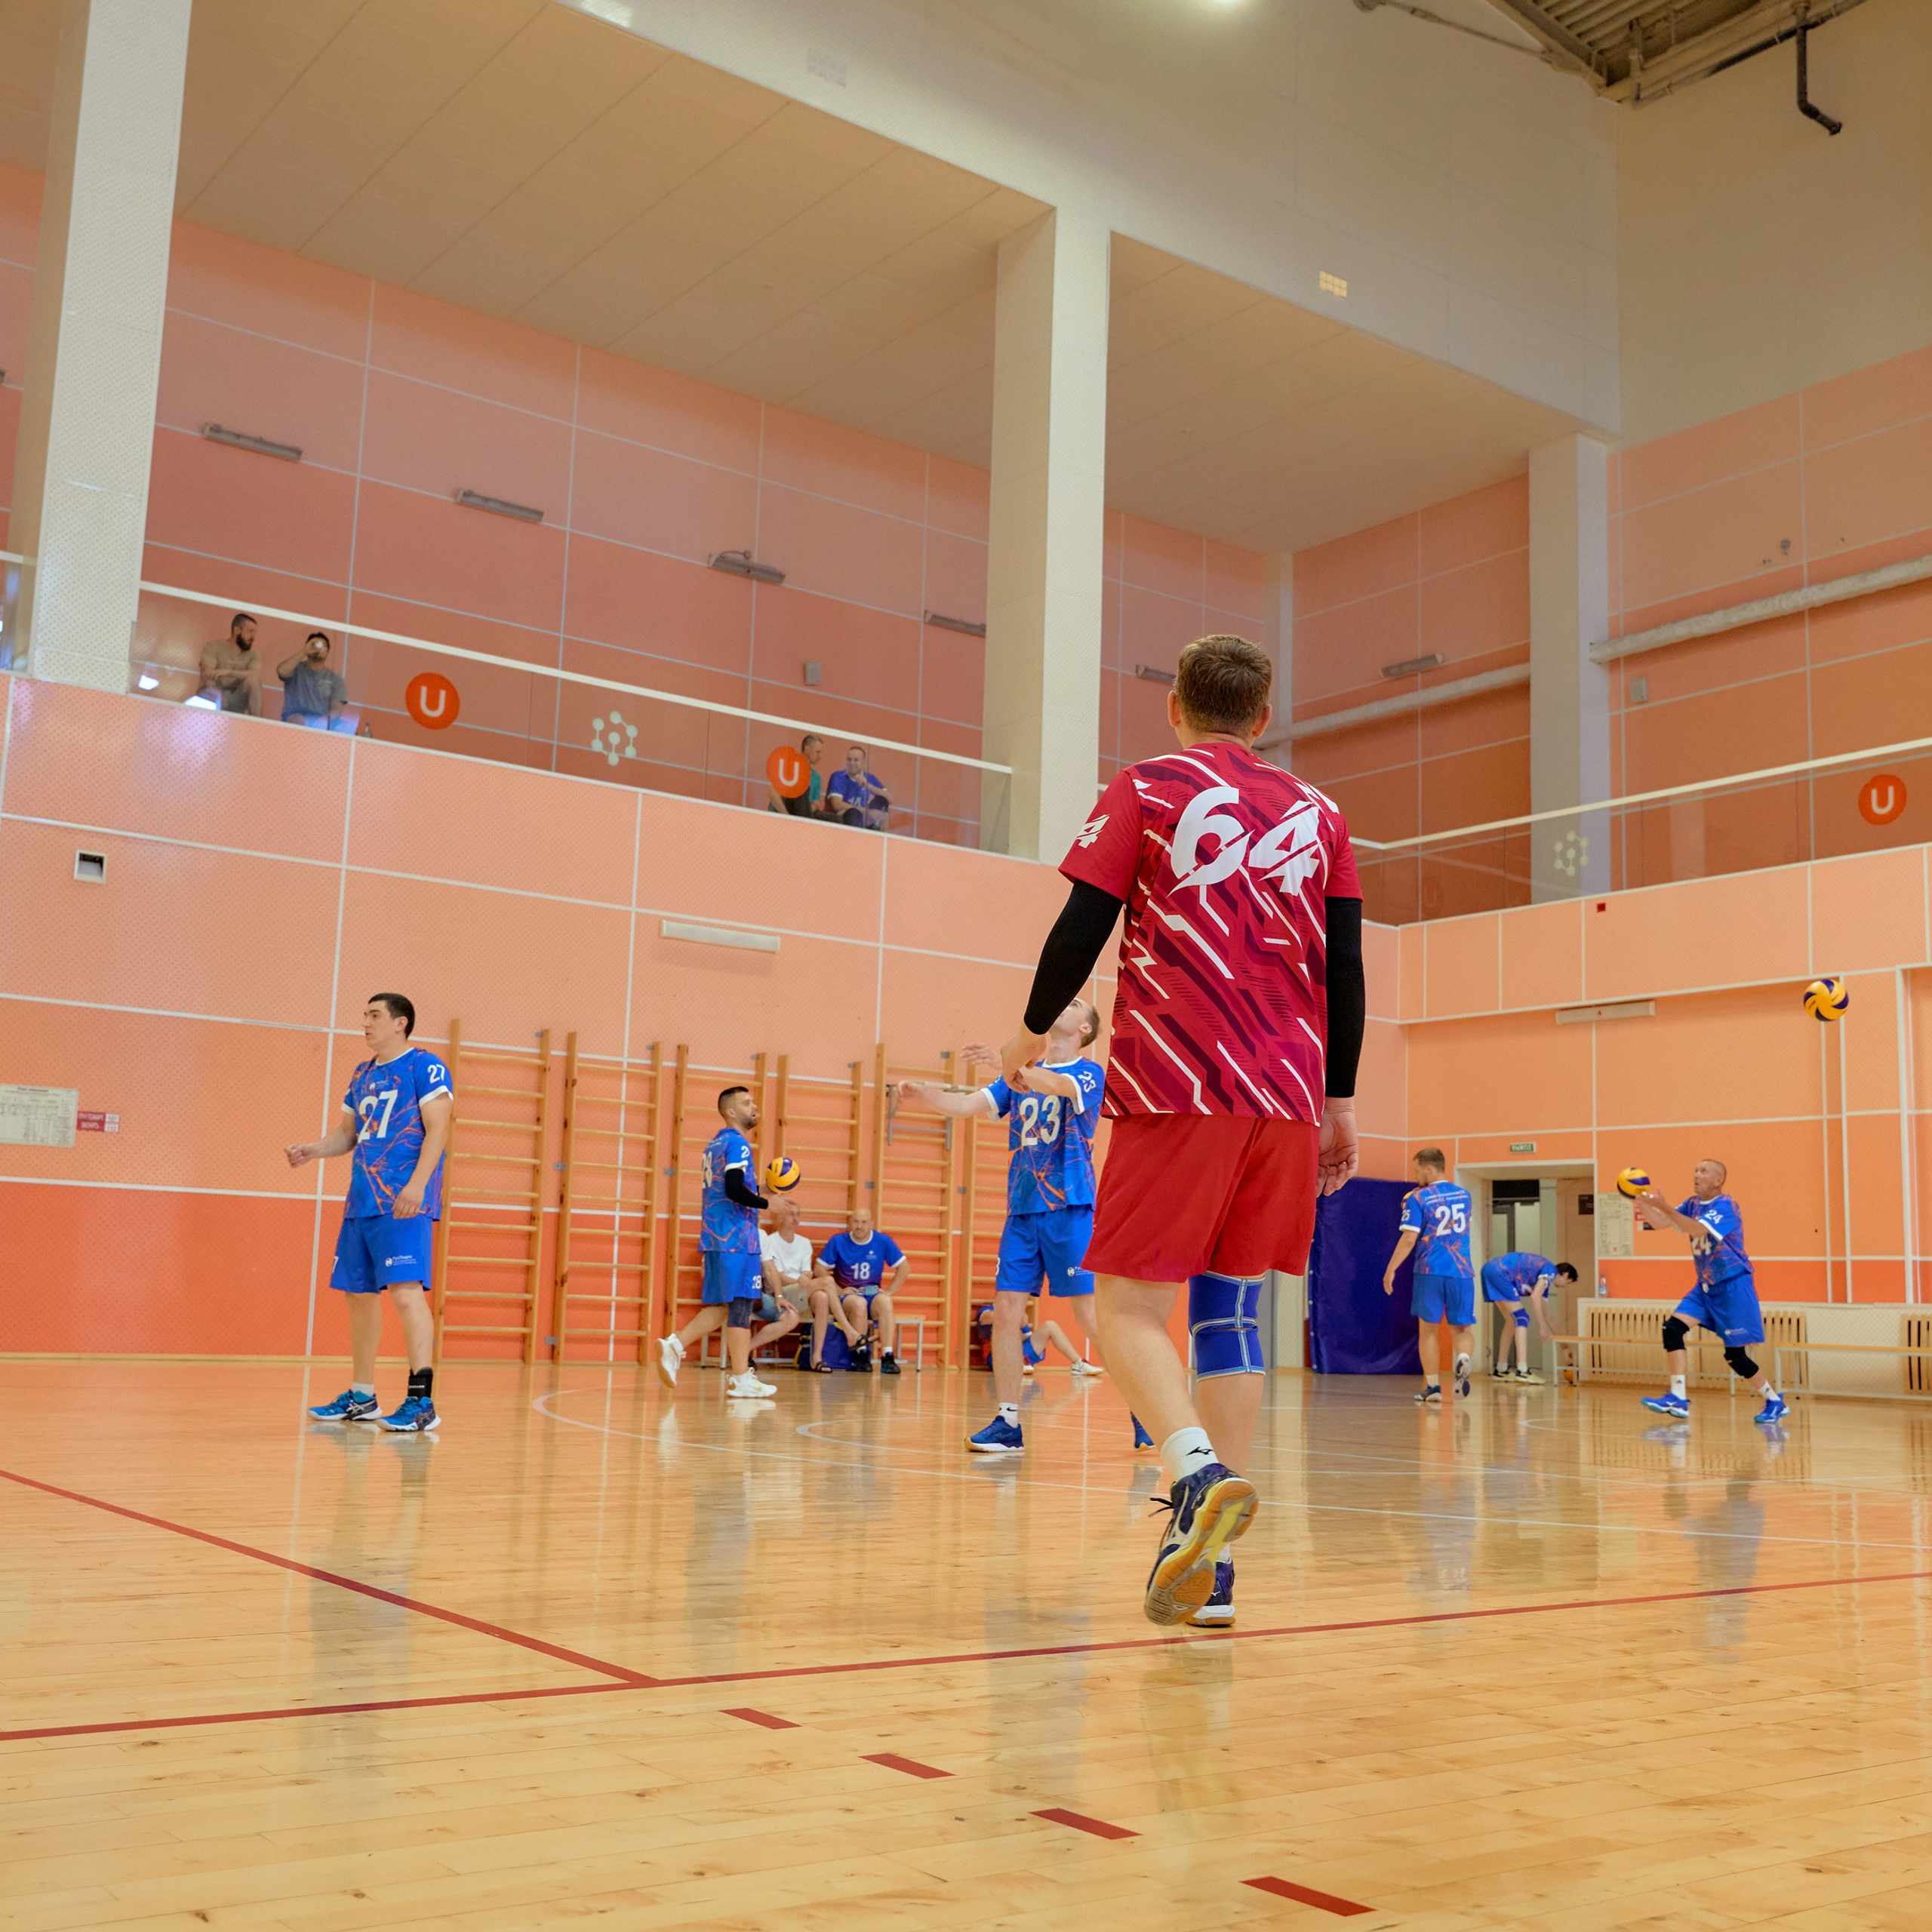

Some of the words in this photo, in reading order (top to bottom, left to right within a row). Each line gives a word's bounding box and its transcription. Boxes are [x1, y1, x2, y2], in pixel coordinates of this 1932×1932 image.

[421, 685, 446, 718] U
[779, 758, 800, 786] U
[1871, 785, 1894, 814] U
[1076, 814, 1110, 849] 4
[1165, 786, 1326, 898] 64
[427, 1063, 445, 1084] 27
[1078, 1071, 1097, 1093] 23
[358, 1090, 398, 1143] 27
[1020, 1094, 1061, 1146] 23
[741, 1146, 750, 1158] 2
[1435, 1203, 1466, 1236] 25
[1704, 1209, 1724, 1225] 24
[752, 1275, 761, 1289] 28
[851, 1262, 870, 1280] 18
